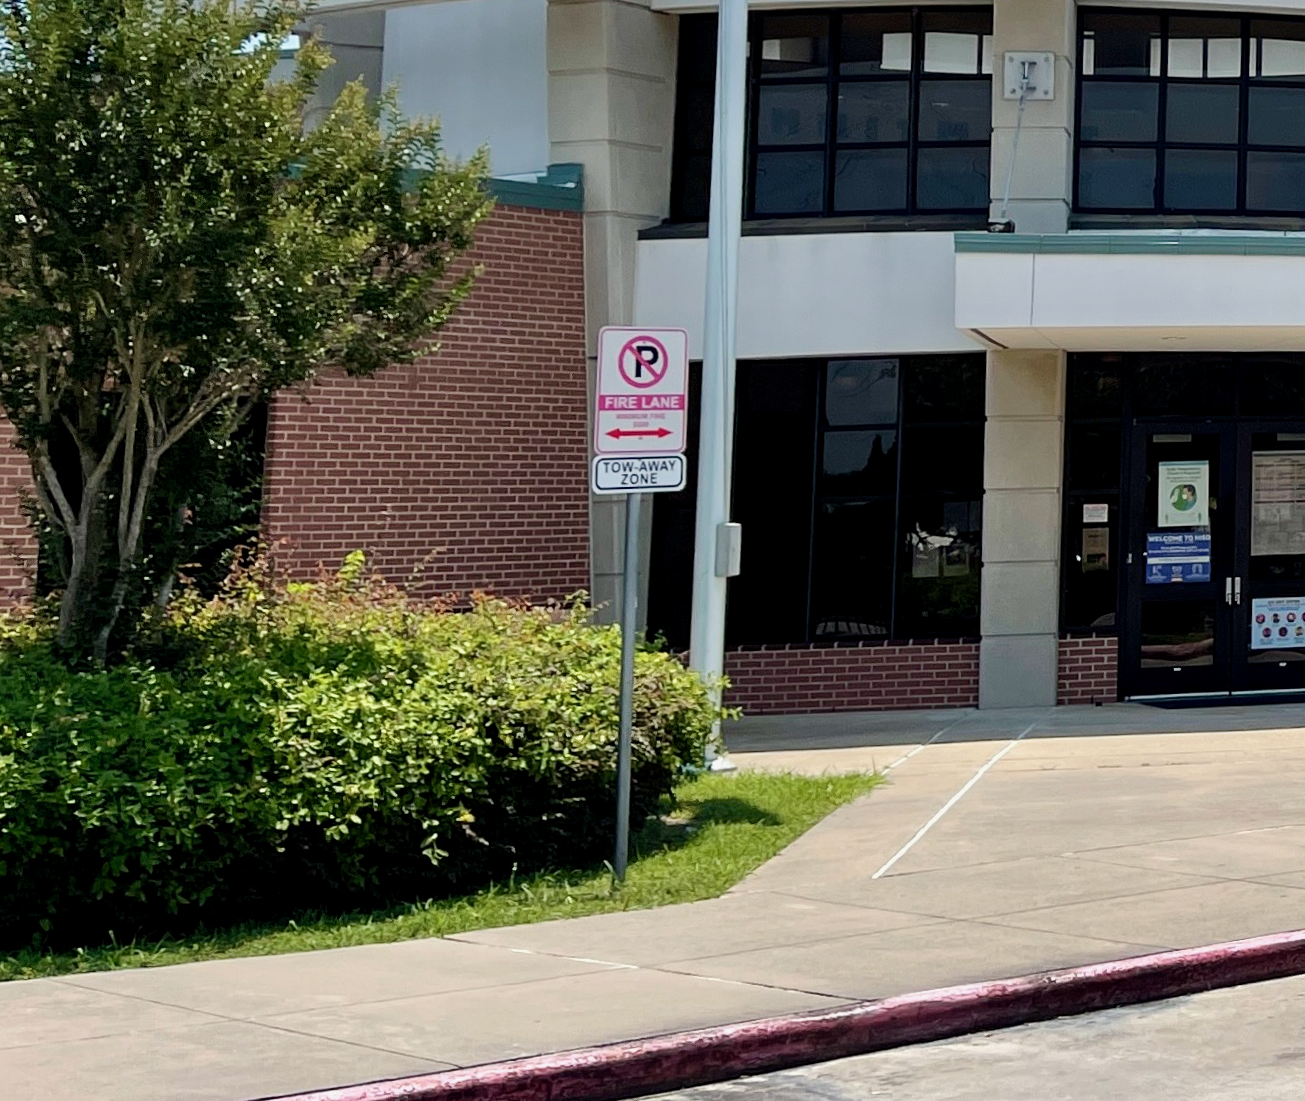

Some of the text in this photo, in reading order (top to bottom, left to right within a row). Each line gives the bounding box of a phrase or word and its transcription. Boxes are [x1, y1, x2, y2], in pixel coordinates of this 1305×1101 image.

[604, 396, 680, 409] FIRE LANE
[602, 460, 677, 474] TOW-AWAY
[621, 473, 658, 485] ZONE
